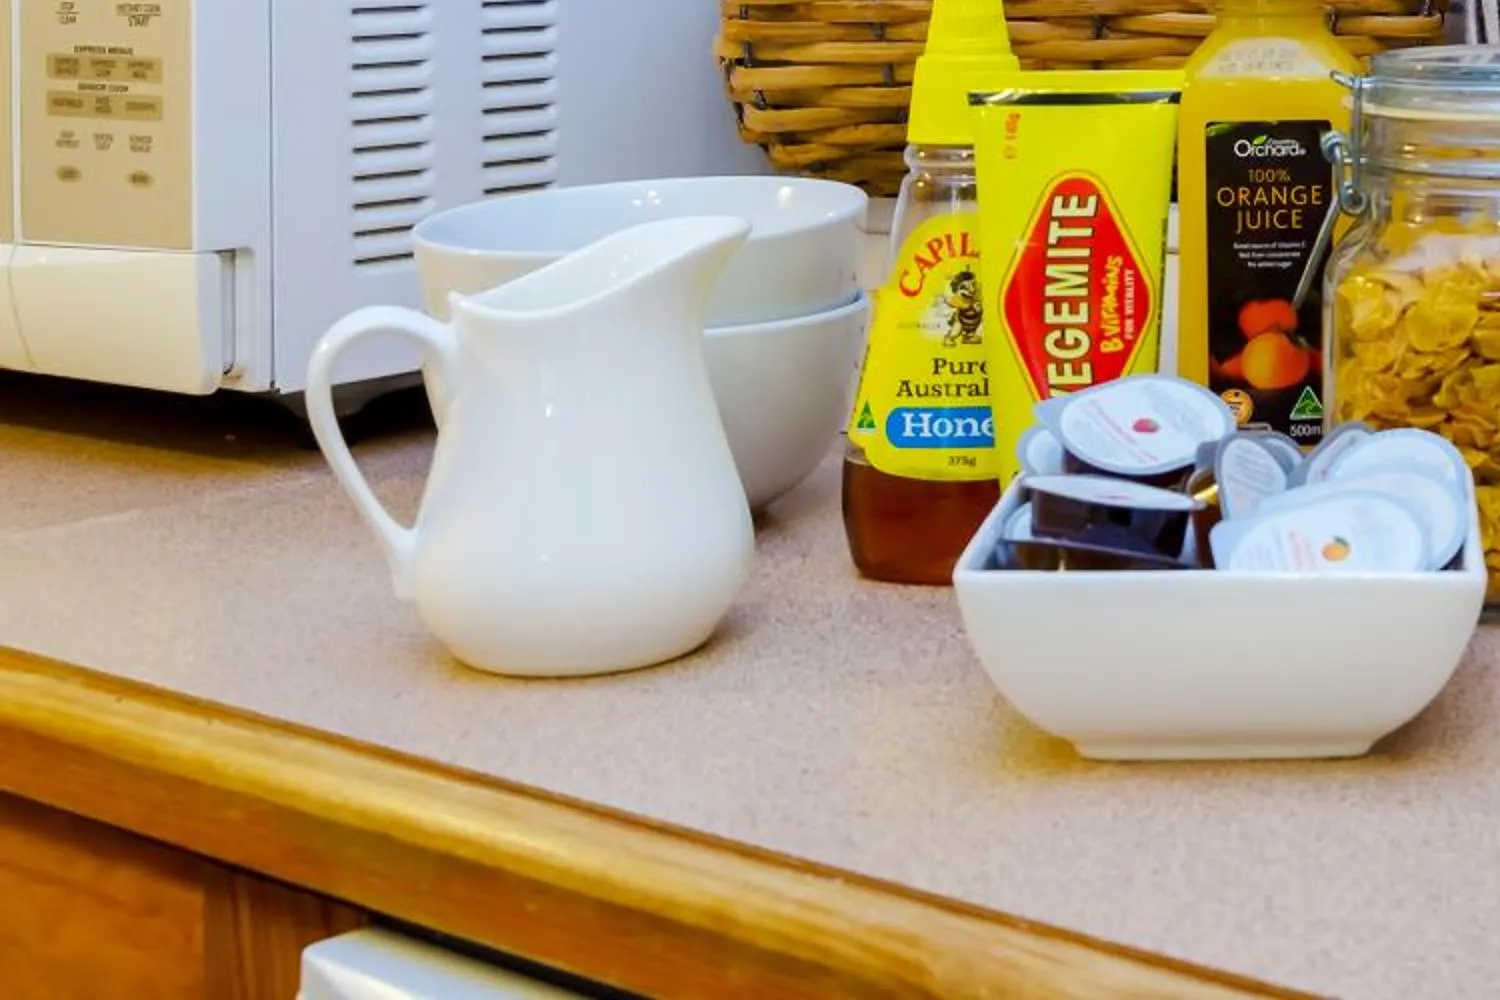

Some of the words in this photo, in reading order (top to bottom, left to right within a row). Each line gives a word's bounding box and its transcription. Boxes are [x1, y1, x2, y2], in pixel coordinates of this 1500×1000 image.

[1233, 138, 1300, 157] Orchard
[1248, 168, 1291, 183] 100%
[1216, 184, 1323, 207] ORANGE
[1236, 209, 1304, 234] JUICE
[899, 231, 981, 299] CAPIL
[896, 378, 990, 398] Austral
